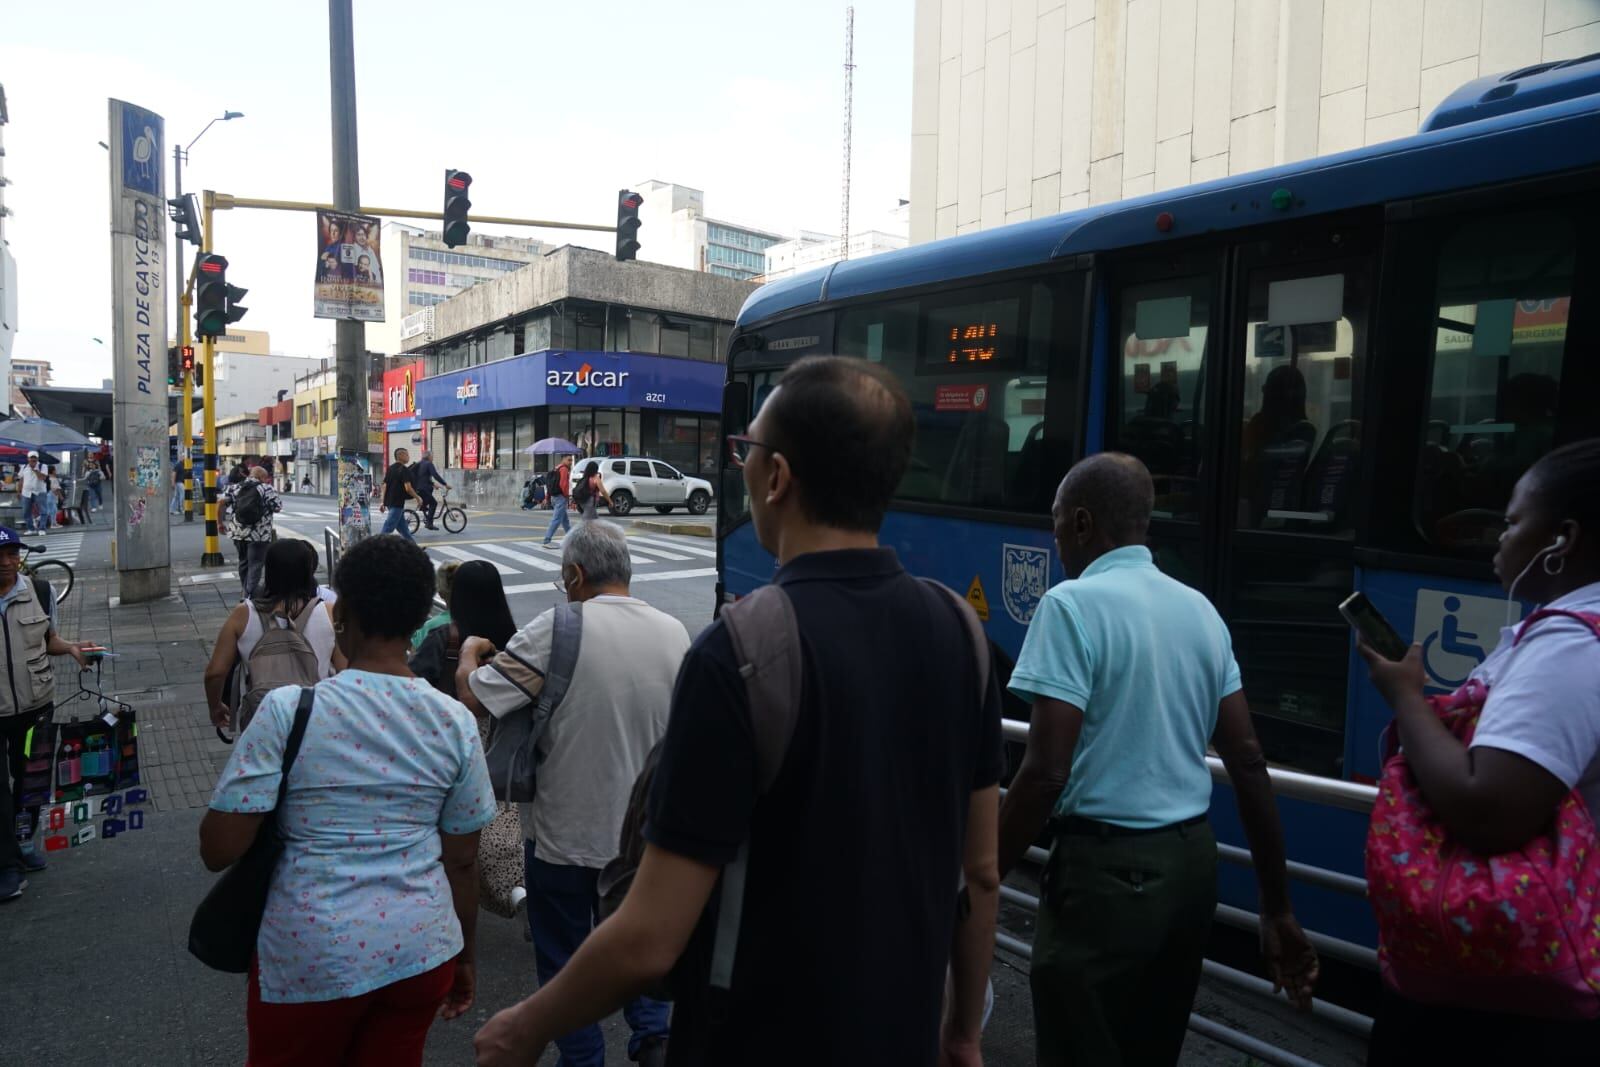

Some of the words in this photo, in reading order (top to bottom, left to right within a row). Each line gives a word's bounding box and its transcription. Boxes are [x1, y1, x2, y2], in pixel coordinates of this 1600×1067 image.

[135, 200, 149, 296] CAYCEDO
[151, 250, 160, 265] 13
[136, 298, 150, 326] DE
[1444, 336, 1472, 344] SALID
[137, 333, 151, 395] PLAZA
[0, 531, 10, 540] A
